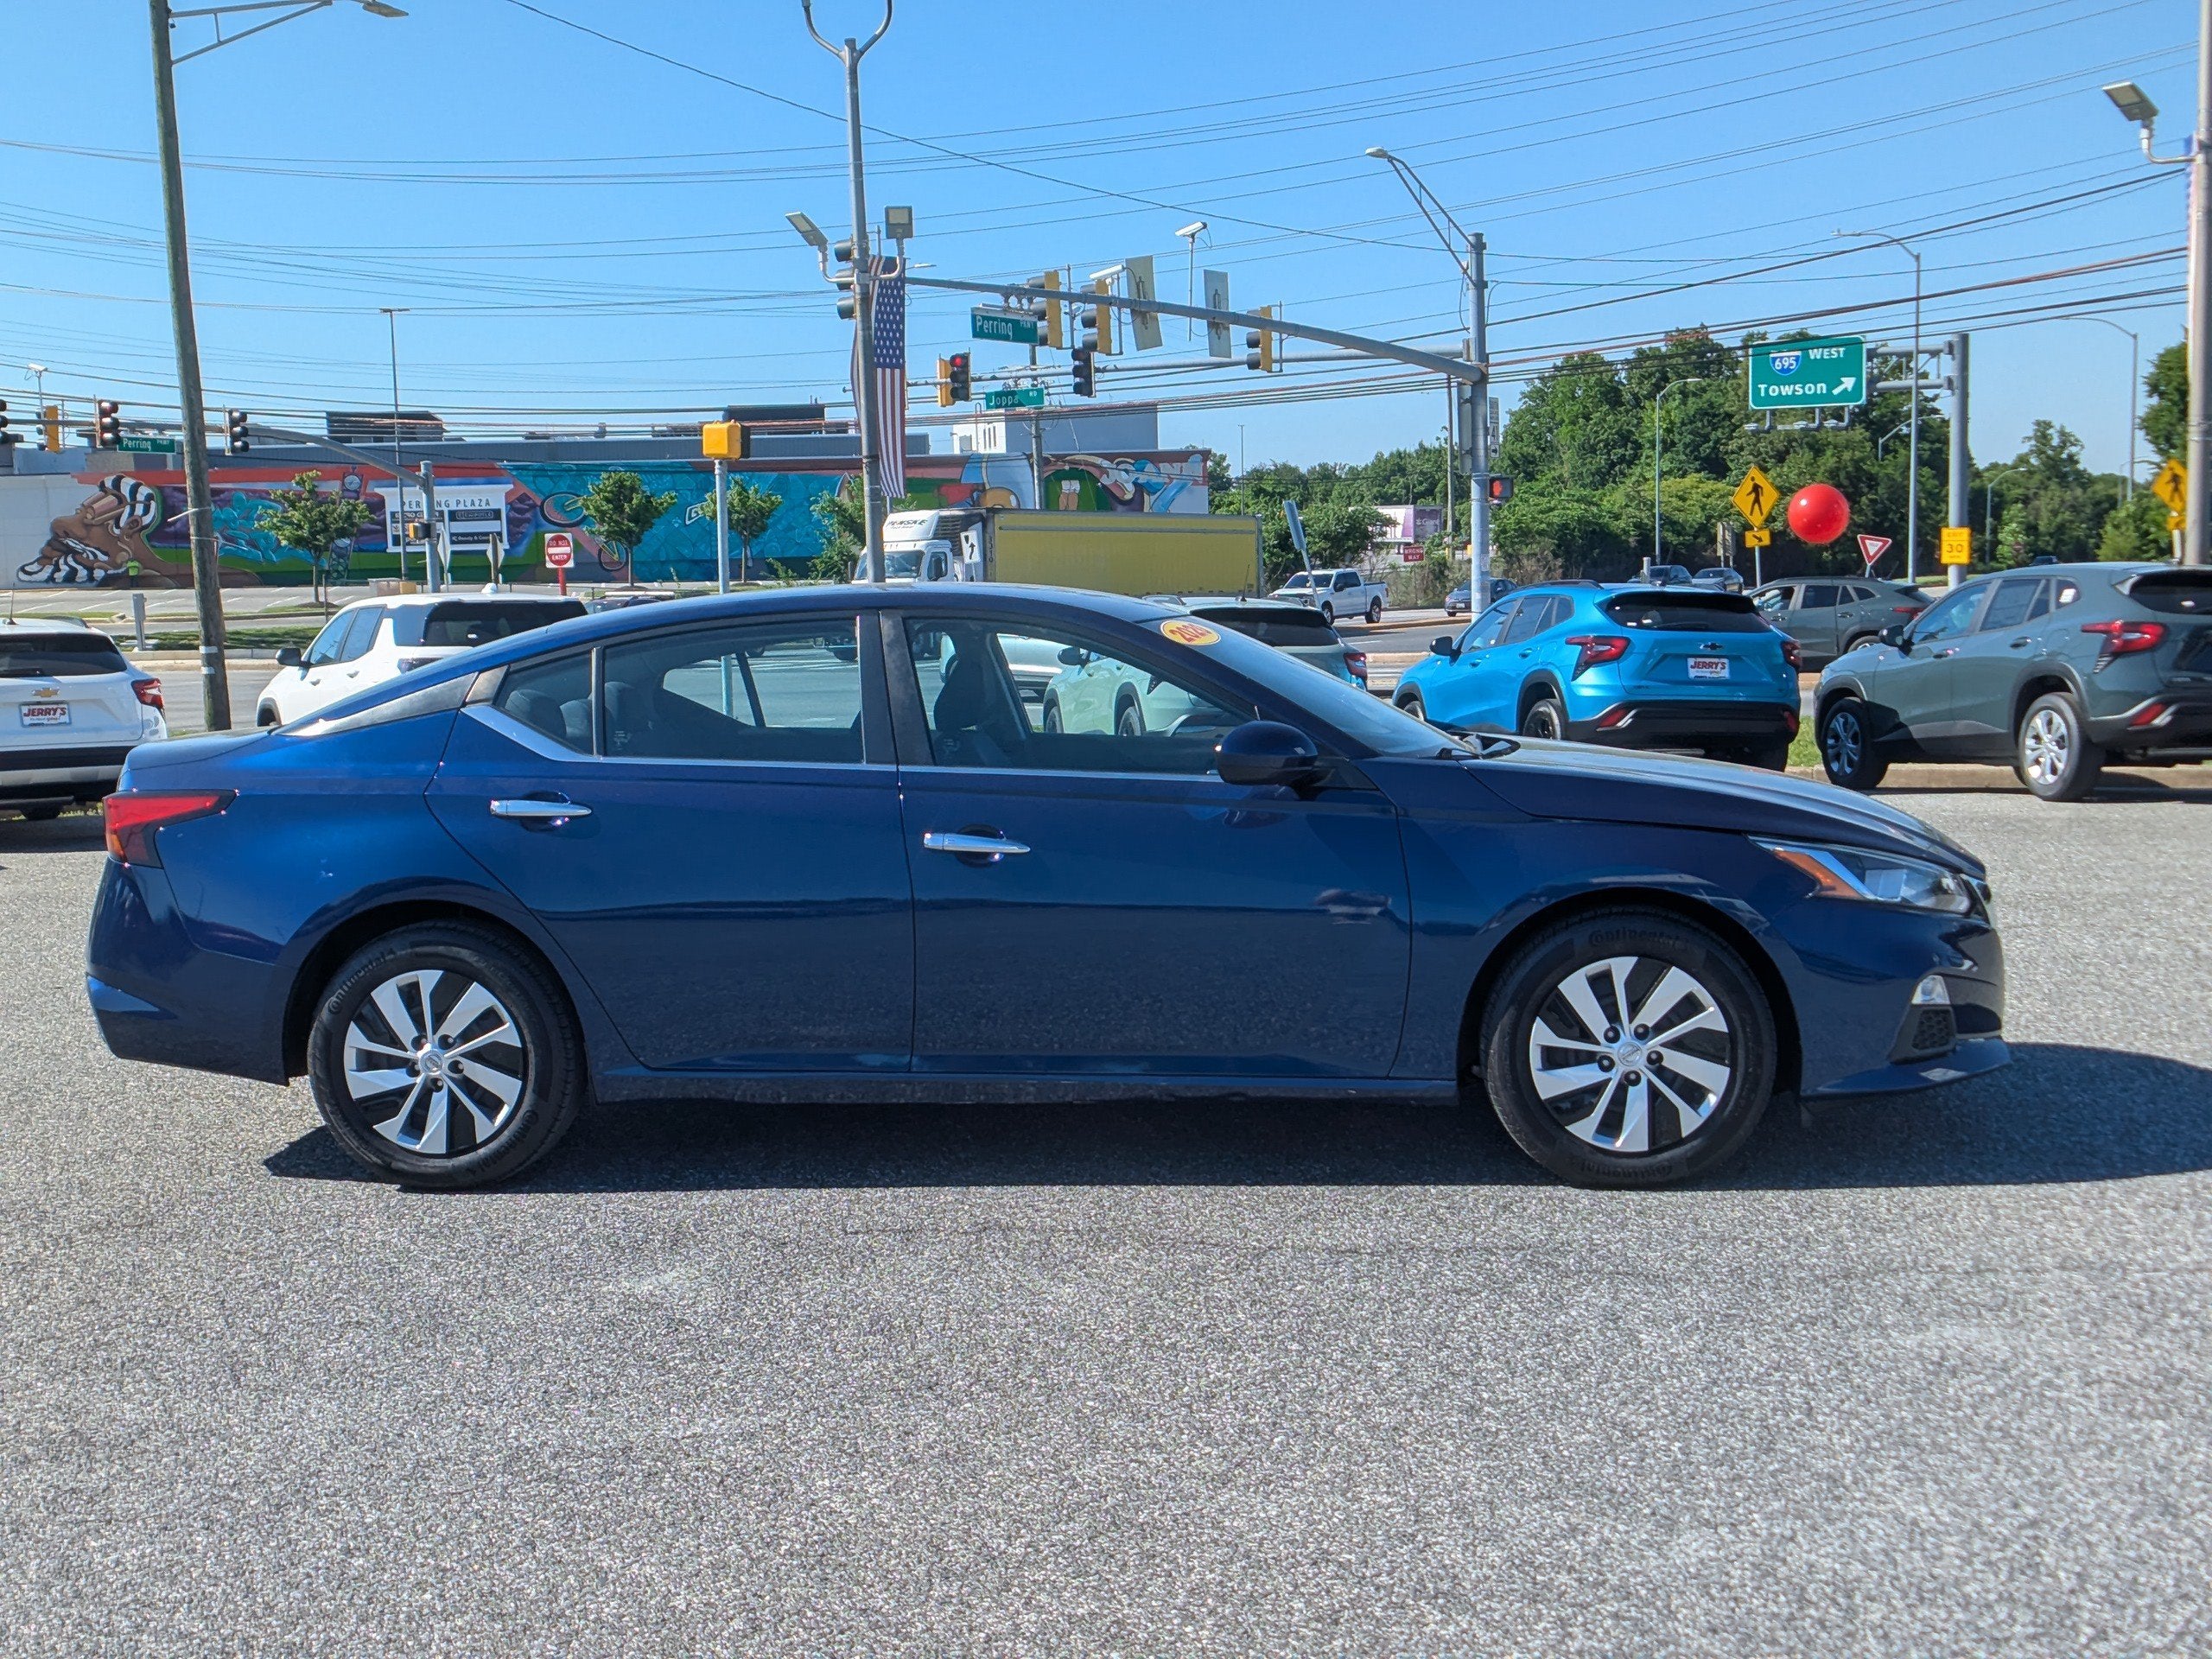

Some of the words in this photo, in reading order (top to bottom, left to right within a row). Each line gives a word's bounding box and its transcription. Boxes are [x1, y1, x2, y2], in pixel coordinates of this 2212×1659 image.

[976, 315, 1013, 340] Perring
[1808, 347, 1846, 360] WEST
[1774, 357, 1797, 370] 695
[988, 396, 1019, 406] Joppa
[123, 437, 152, 452] Perring
[455, 499, 491, 508] PLAZA
[1946, 543, 1963, 553] 30
[1690, 660, 1727, 671] JERRY'S
[23, 707, 67, 717] JERRY'S
